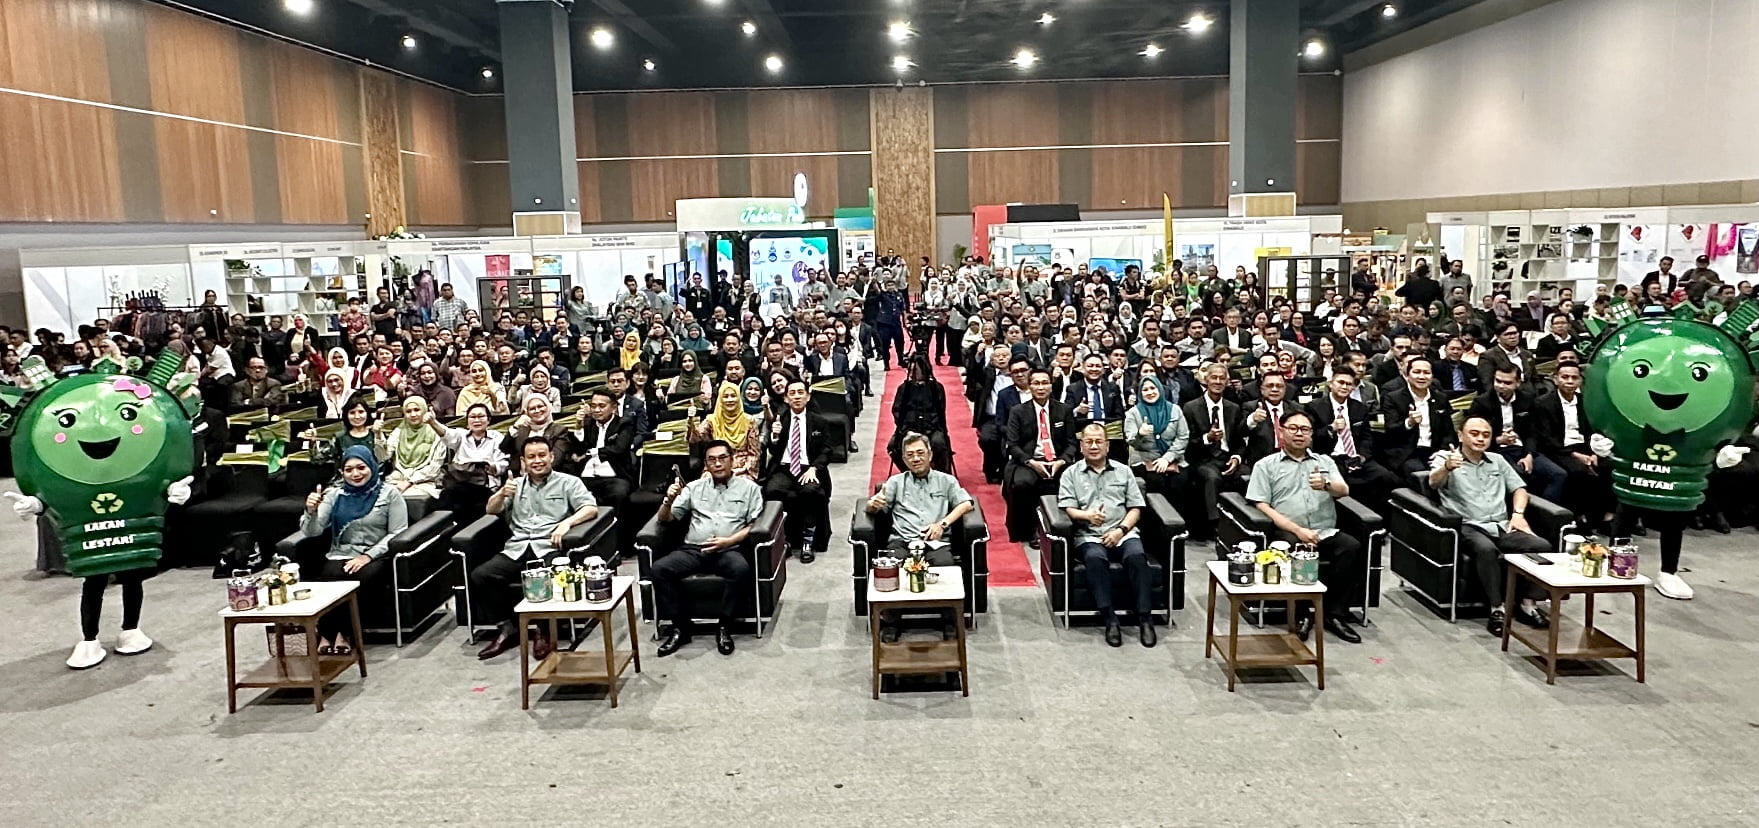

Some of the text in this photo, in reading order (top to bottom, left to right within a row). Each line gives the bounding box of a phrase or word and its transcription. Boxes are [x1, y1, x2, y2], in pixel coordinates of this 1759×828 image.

[1633, 461, 1671, 474] RAKAN
[1629, 476, 1674, 490] LESTARI
[84, 519, 126, 532] RAKAN
[82, 534, 136, 550] LESTARI
